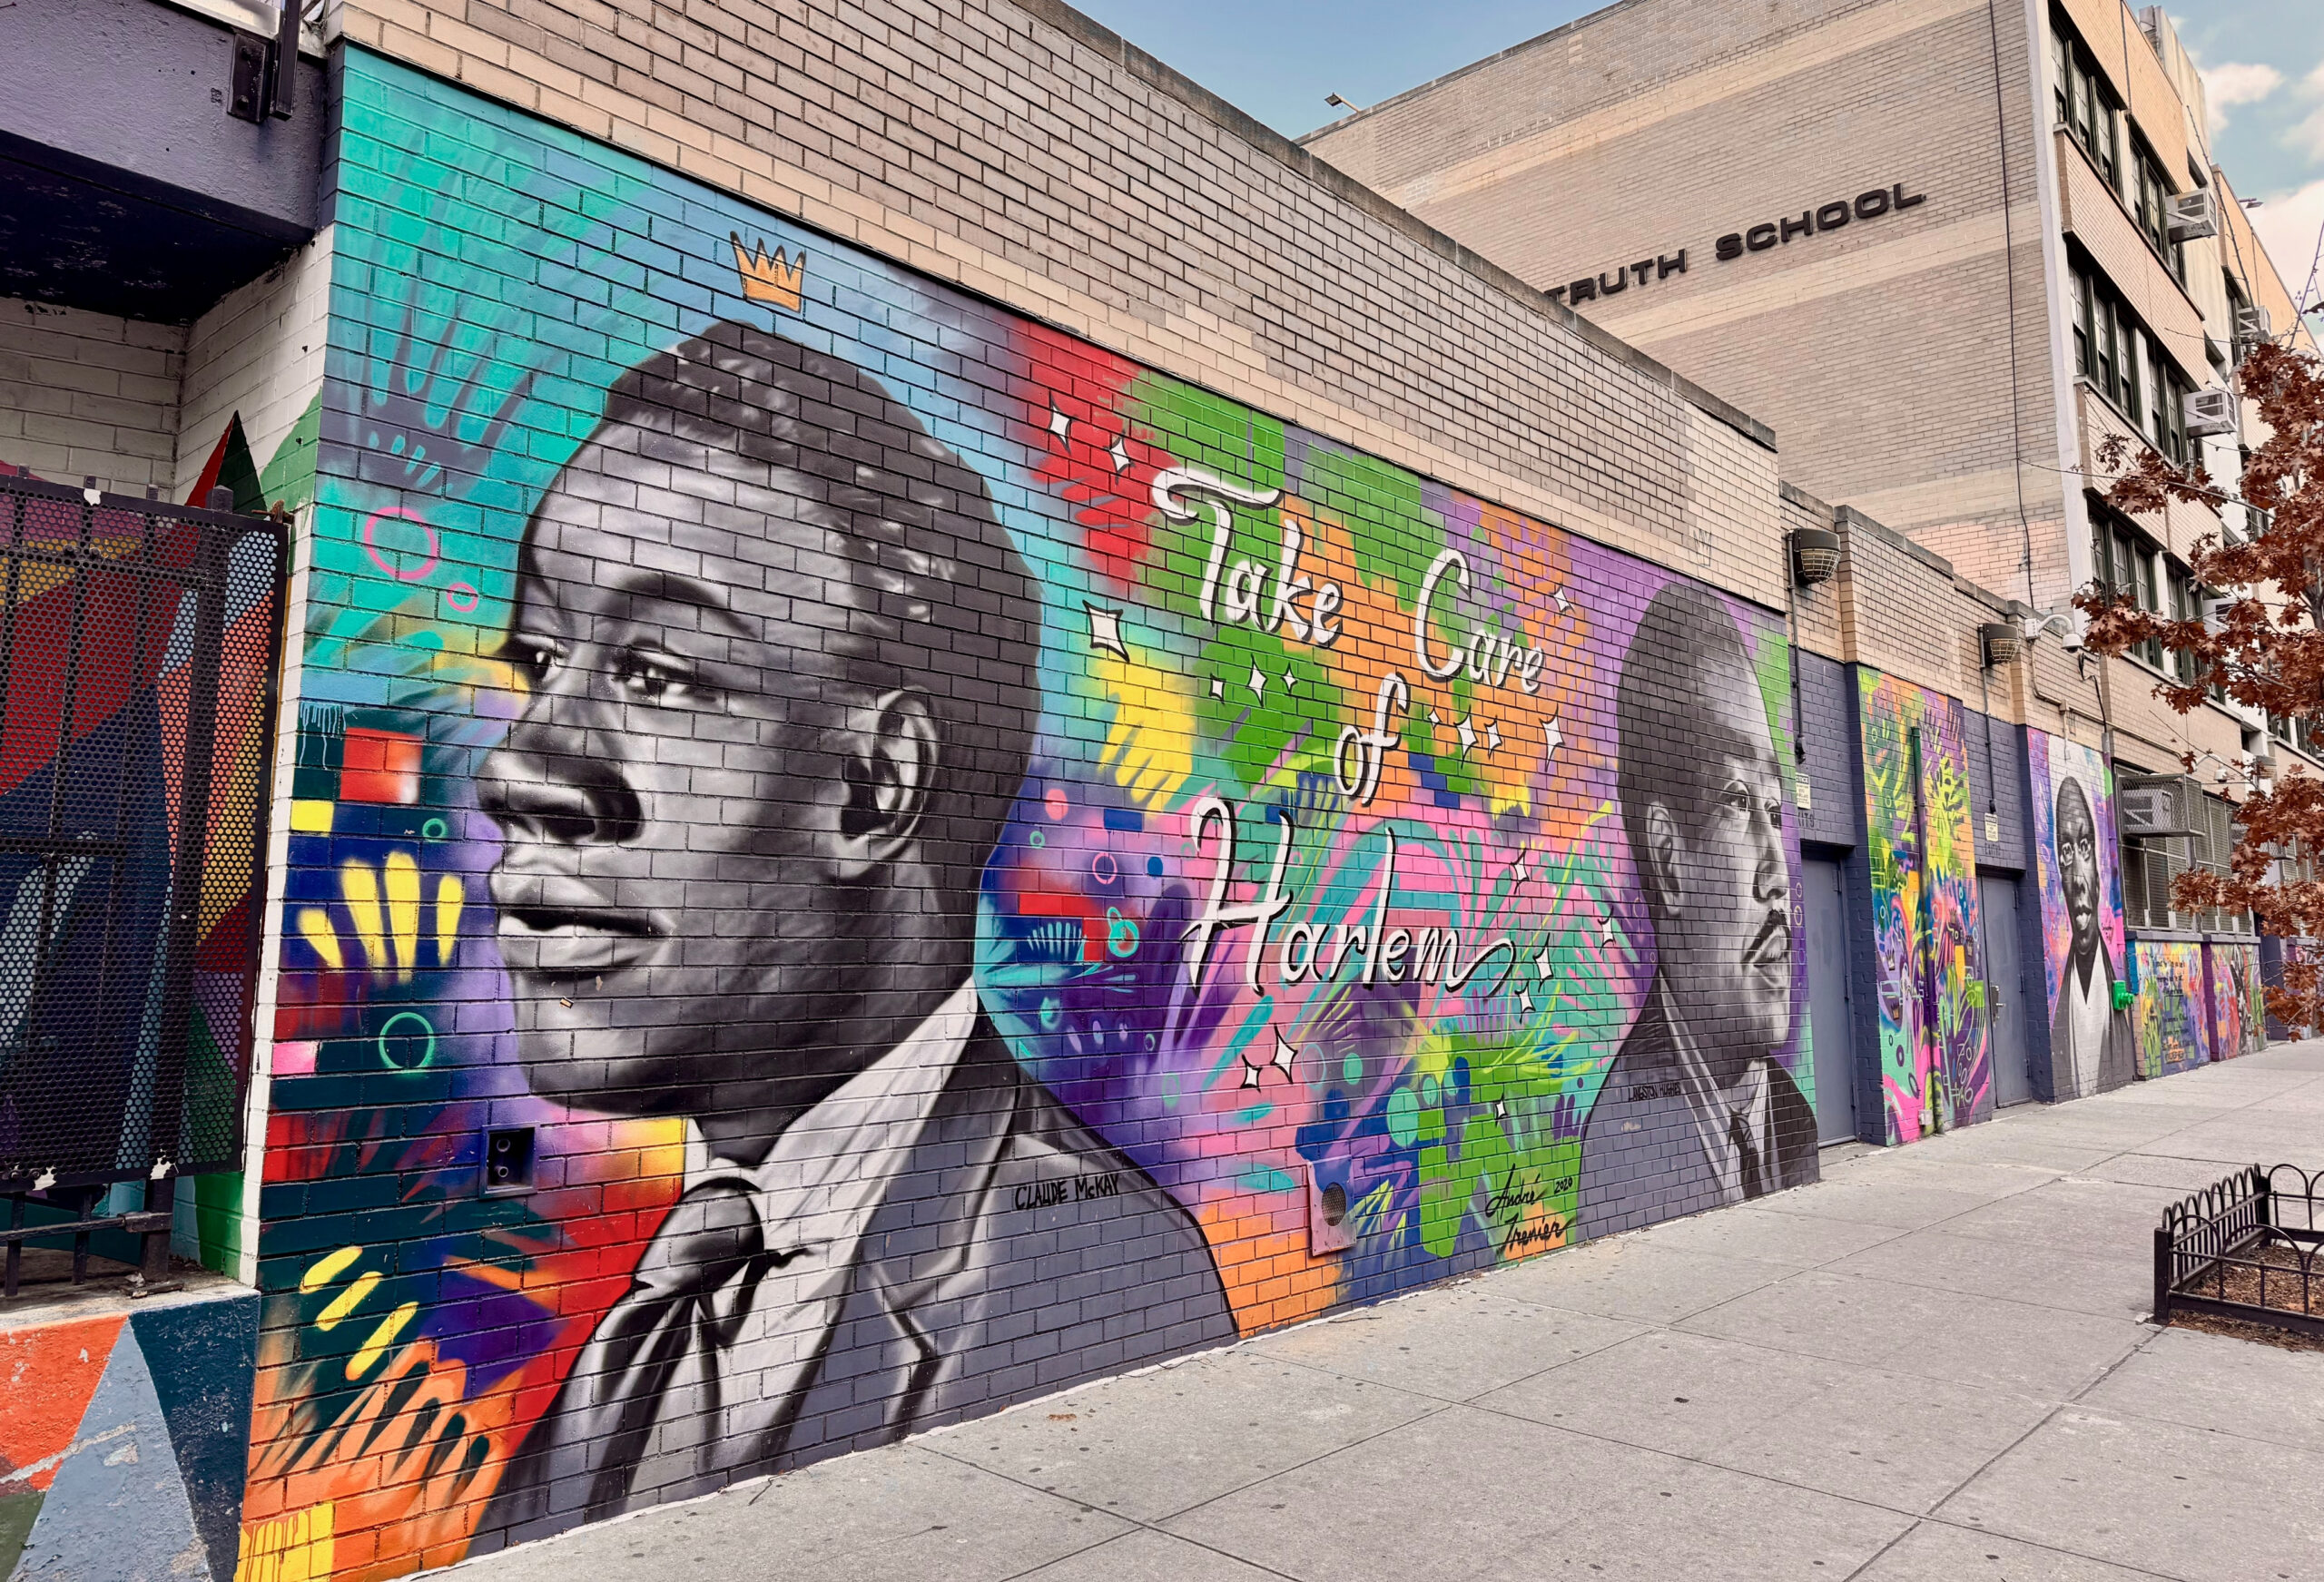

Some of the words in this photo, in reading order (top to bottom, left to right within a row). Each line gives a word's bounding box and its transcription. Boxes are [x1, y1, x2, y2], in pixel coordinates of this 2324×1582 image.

[1543, 249, 1688, 305] TRUTH
[1715, 182, 1927, 260] SCHOOL
[1152, 467, 1344, 648] Take
[1414, 547, 1545, 695] Care
[1334, 673, 1411, 808] of
[1180, 795, 1517, 997] Harlem
[1015, 1181, 1068, 1210] CLAUDE
[1074, 1173, 1120, 1202] McKAY
[1553, 1176, 1573, 1194] 2020
